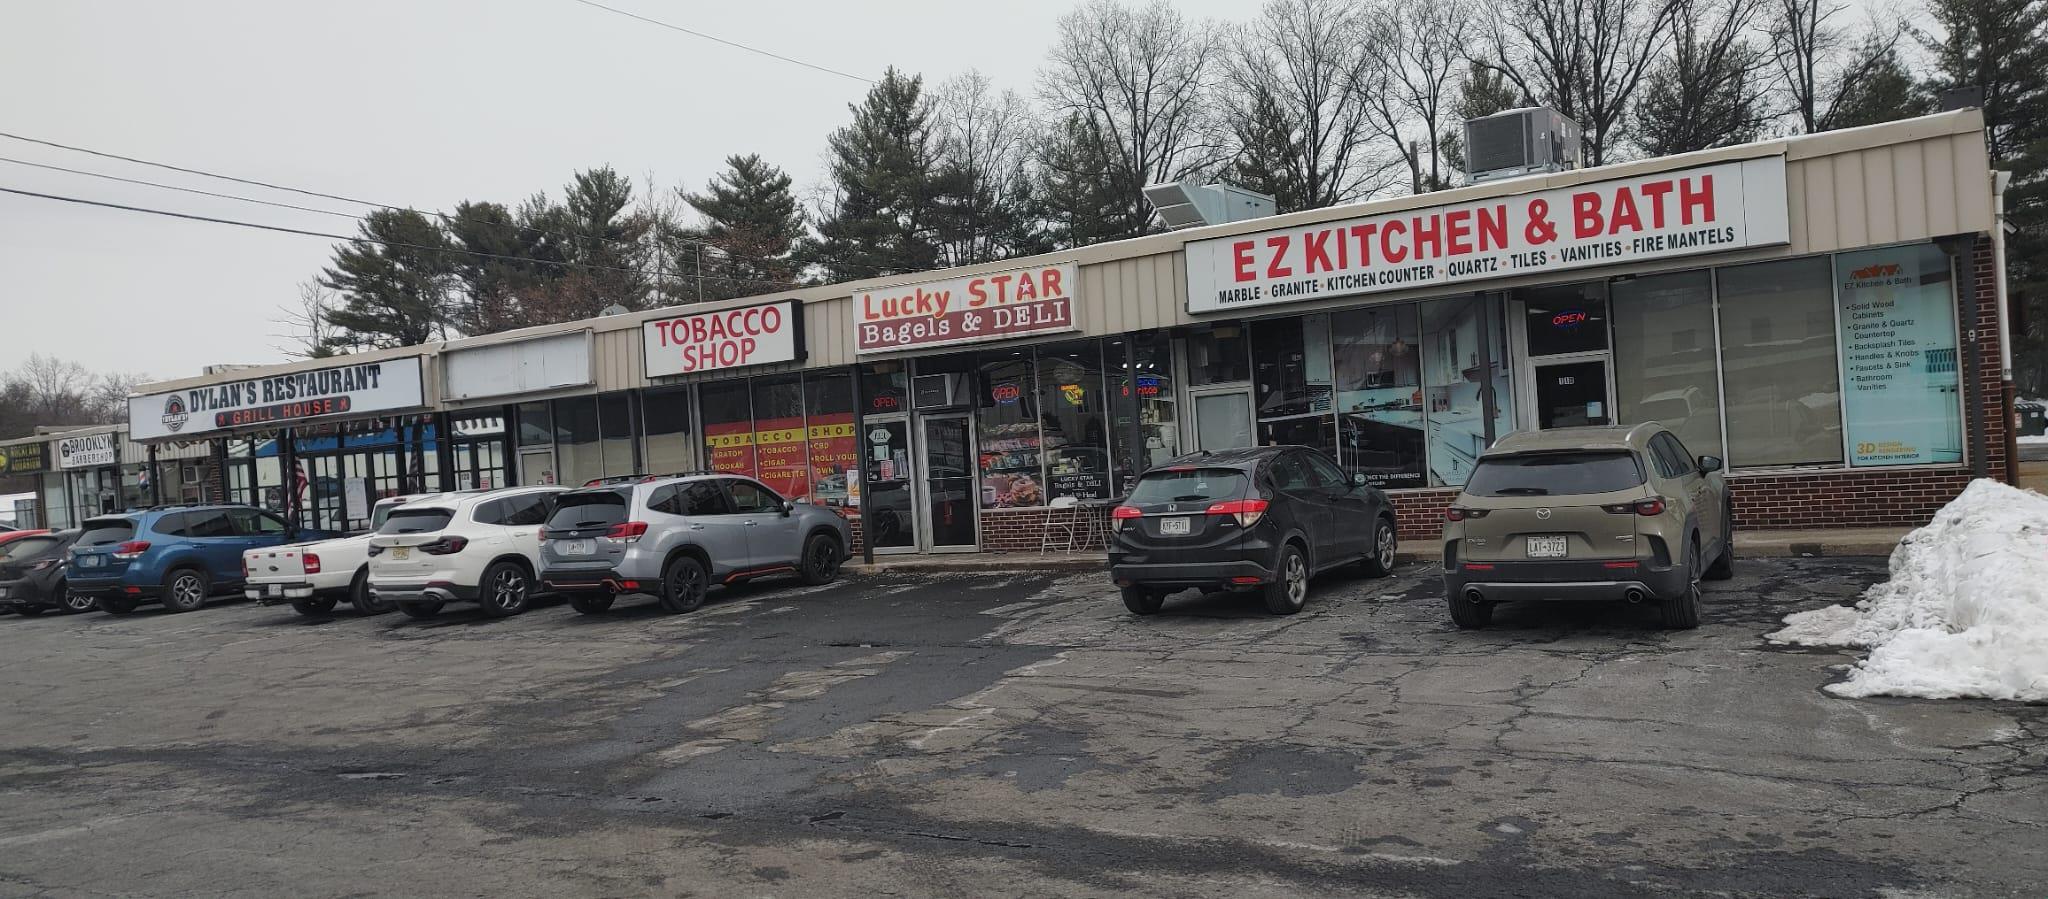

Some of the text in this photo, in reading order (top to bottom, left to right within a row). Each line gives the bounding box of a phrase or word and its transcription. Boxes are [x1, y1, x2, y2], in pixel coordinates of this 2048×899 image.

[1304, 204, 1509, 274] KITCHEN
[1524, 198, 1558, 246] &
[1572, 174, 1716, 240] BATH
[1219, 226, 1735, 304] MARBLE GRANITE KITCHEN COUNTER QUARTZ TILES VANITIES FIRE MANTELS
[1856, 279, 1884, 289] Kitchen
[1894, 276, 1912, 285] Bath
[864, 269, 1063, 319] Lucky STAR
[1851, 300, 1895, 311] Solid Wood
[1553, 311, 1585, 325] OPEN
[1852, 310, 1885, 320] Cabinets
[655, 306, 781, 347] TOBACCO
[863, 301, 1065, 344] Bagels & DELI
[1852, 322, 1880, 331] Granite
[1890, 319, 1914, 327] Quartz
[1854, 330, 1896, 340] Countertop
[1854, 339, 1916, 350] Backsplash Tiles
[683, 337, 756, 372] SHOP
[1855, 352, 1885, 361] Handles
[1895, 349, 1919, 358] Knobs
[1855, 363, 1884, 372] Faucets
[1894, 361, 1911, 369] Sink
[1856, 373, 1893, 382] Bathroom
[190, 364, 381, 413] DYLAN'S RESTAURANT
[992, 384, 1019, 401] OPEN
[1857, 382, 1887, 391] Vanities
[873, 396, 897, 408] OPEN
[233, 400, 332, 425] GRILL HOUSE
[811, 425, 855, 437] SHOP
[70, 433, 113, 454] BROOKLYN
[1857, 443, 1876, 454] 3D
[762, 446, 798, 455] TOBACCO
[763, 459, 786, 467] CIGAR
[814, 453, 858, 462] ROLL YOUR
[765, 470, 805, 480] CIGARETTE
[816, 467, 834, 475] OWN
